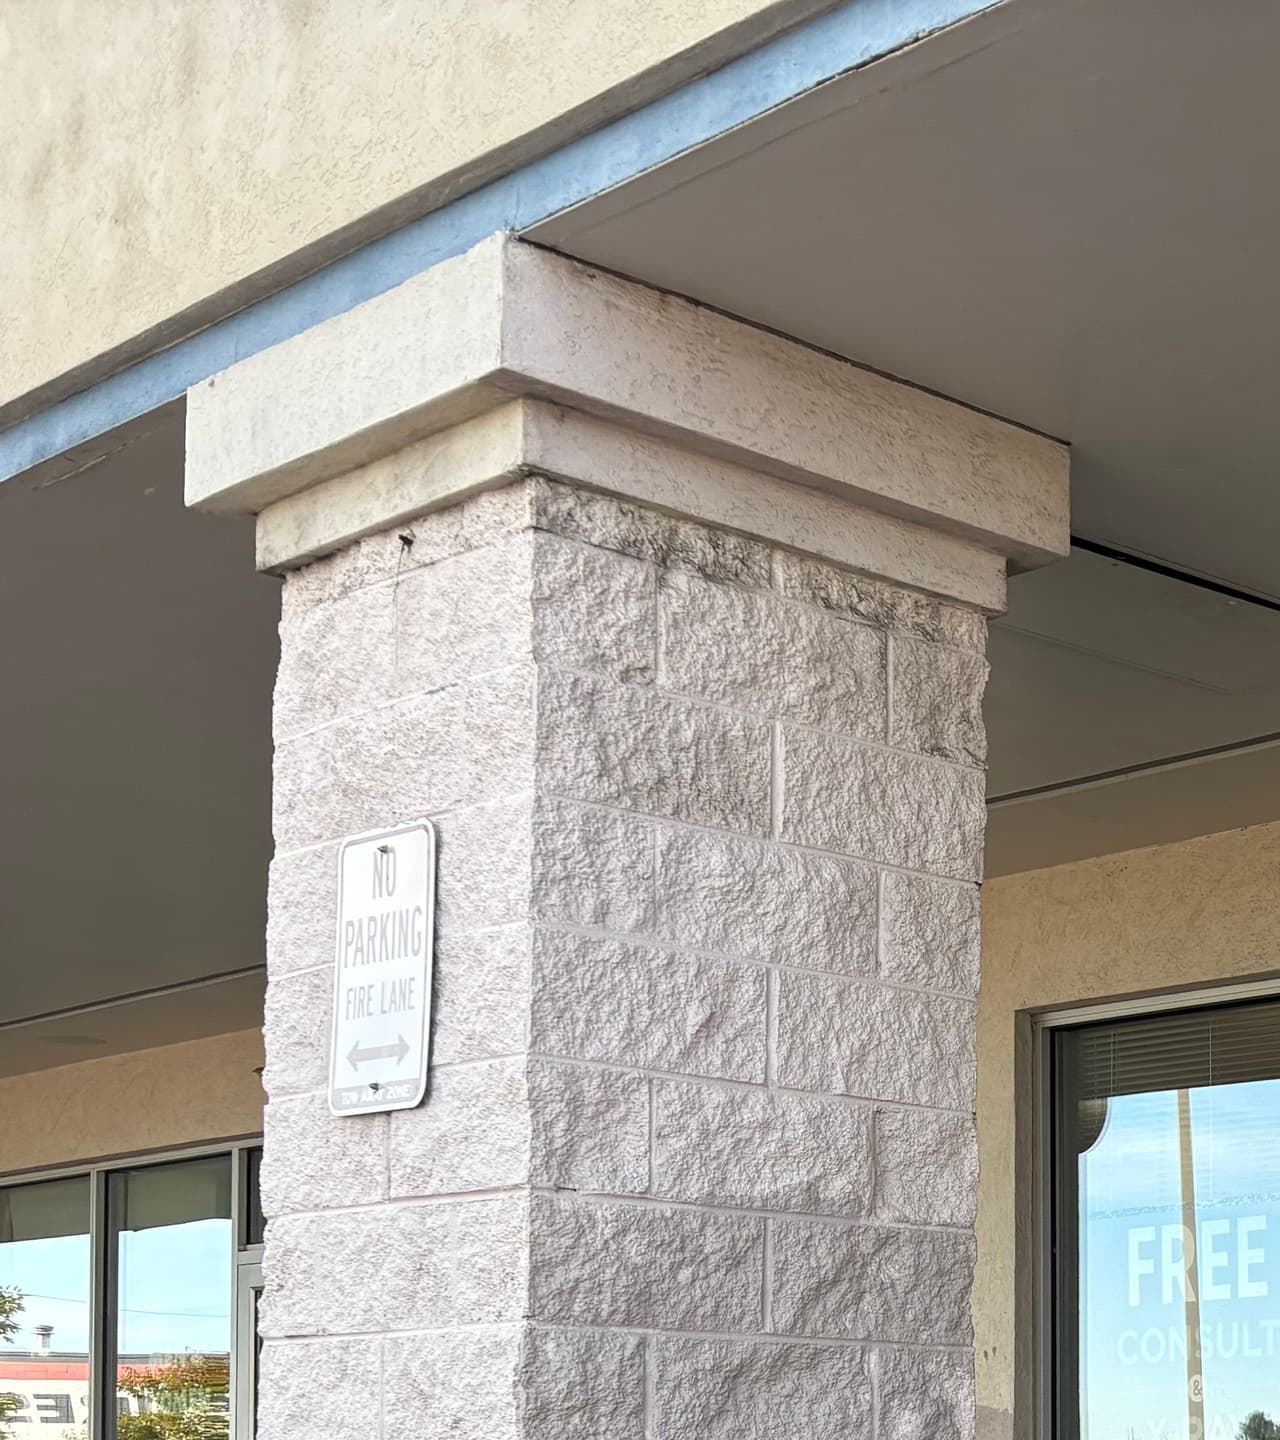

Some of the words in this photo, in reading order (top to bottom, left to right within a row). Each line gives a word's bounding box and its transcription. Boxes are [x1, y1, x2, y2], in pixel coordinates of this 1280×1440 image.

[371, 845, 398, 900] NO
[344, 905, 423, 969] PARKING
[345, 983, 375, 1021] FIRE
[380, 977, 416, 1015] LANE
[1127, 1214, 1269, 1308] FREE
[1117, 1318, 1280, 1365] CONSULT
